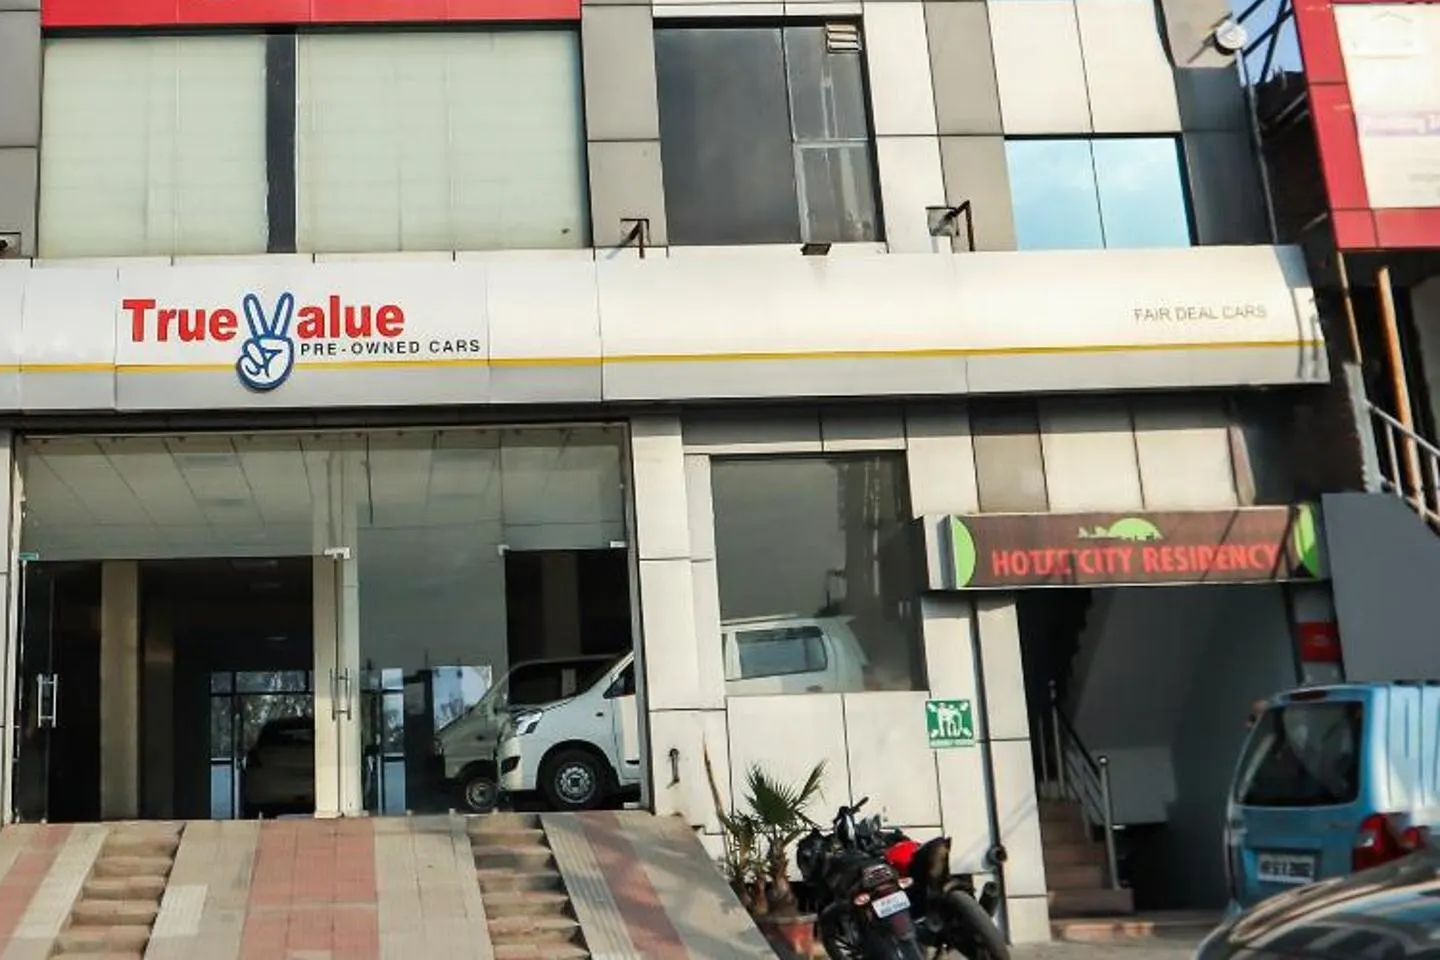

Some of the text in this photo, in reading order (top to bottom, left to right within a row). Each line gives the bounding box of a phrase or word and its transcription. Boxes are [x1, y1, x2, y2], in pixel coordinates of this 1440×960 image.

[122, 298, 238, 343] True
[1133, 303, 1268, 322] FAIR DEAL CARS
[428, 339, 481, 355] CARS
[1078, 544, 1134, 576] CITY
[1142, 542, 1279, 573] RESIDENCY
